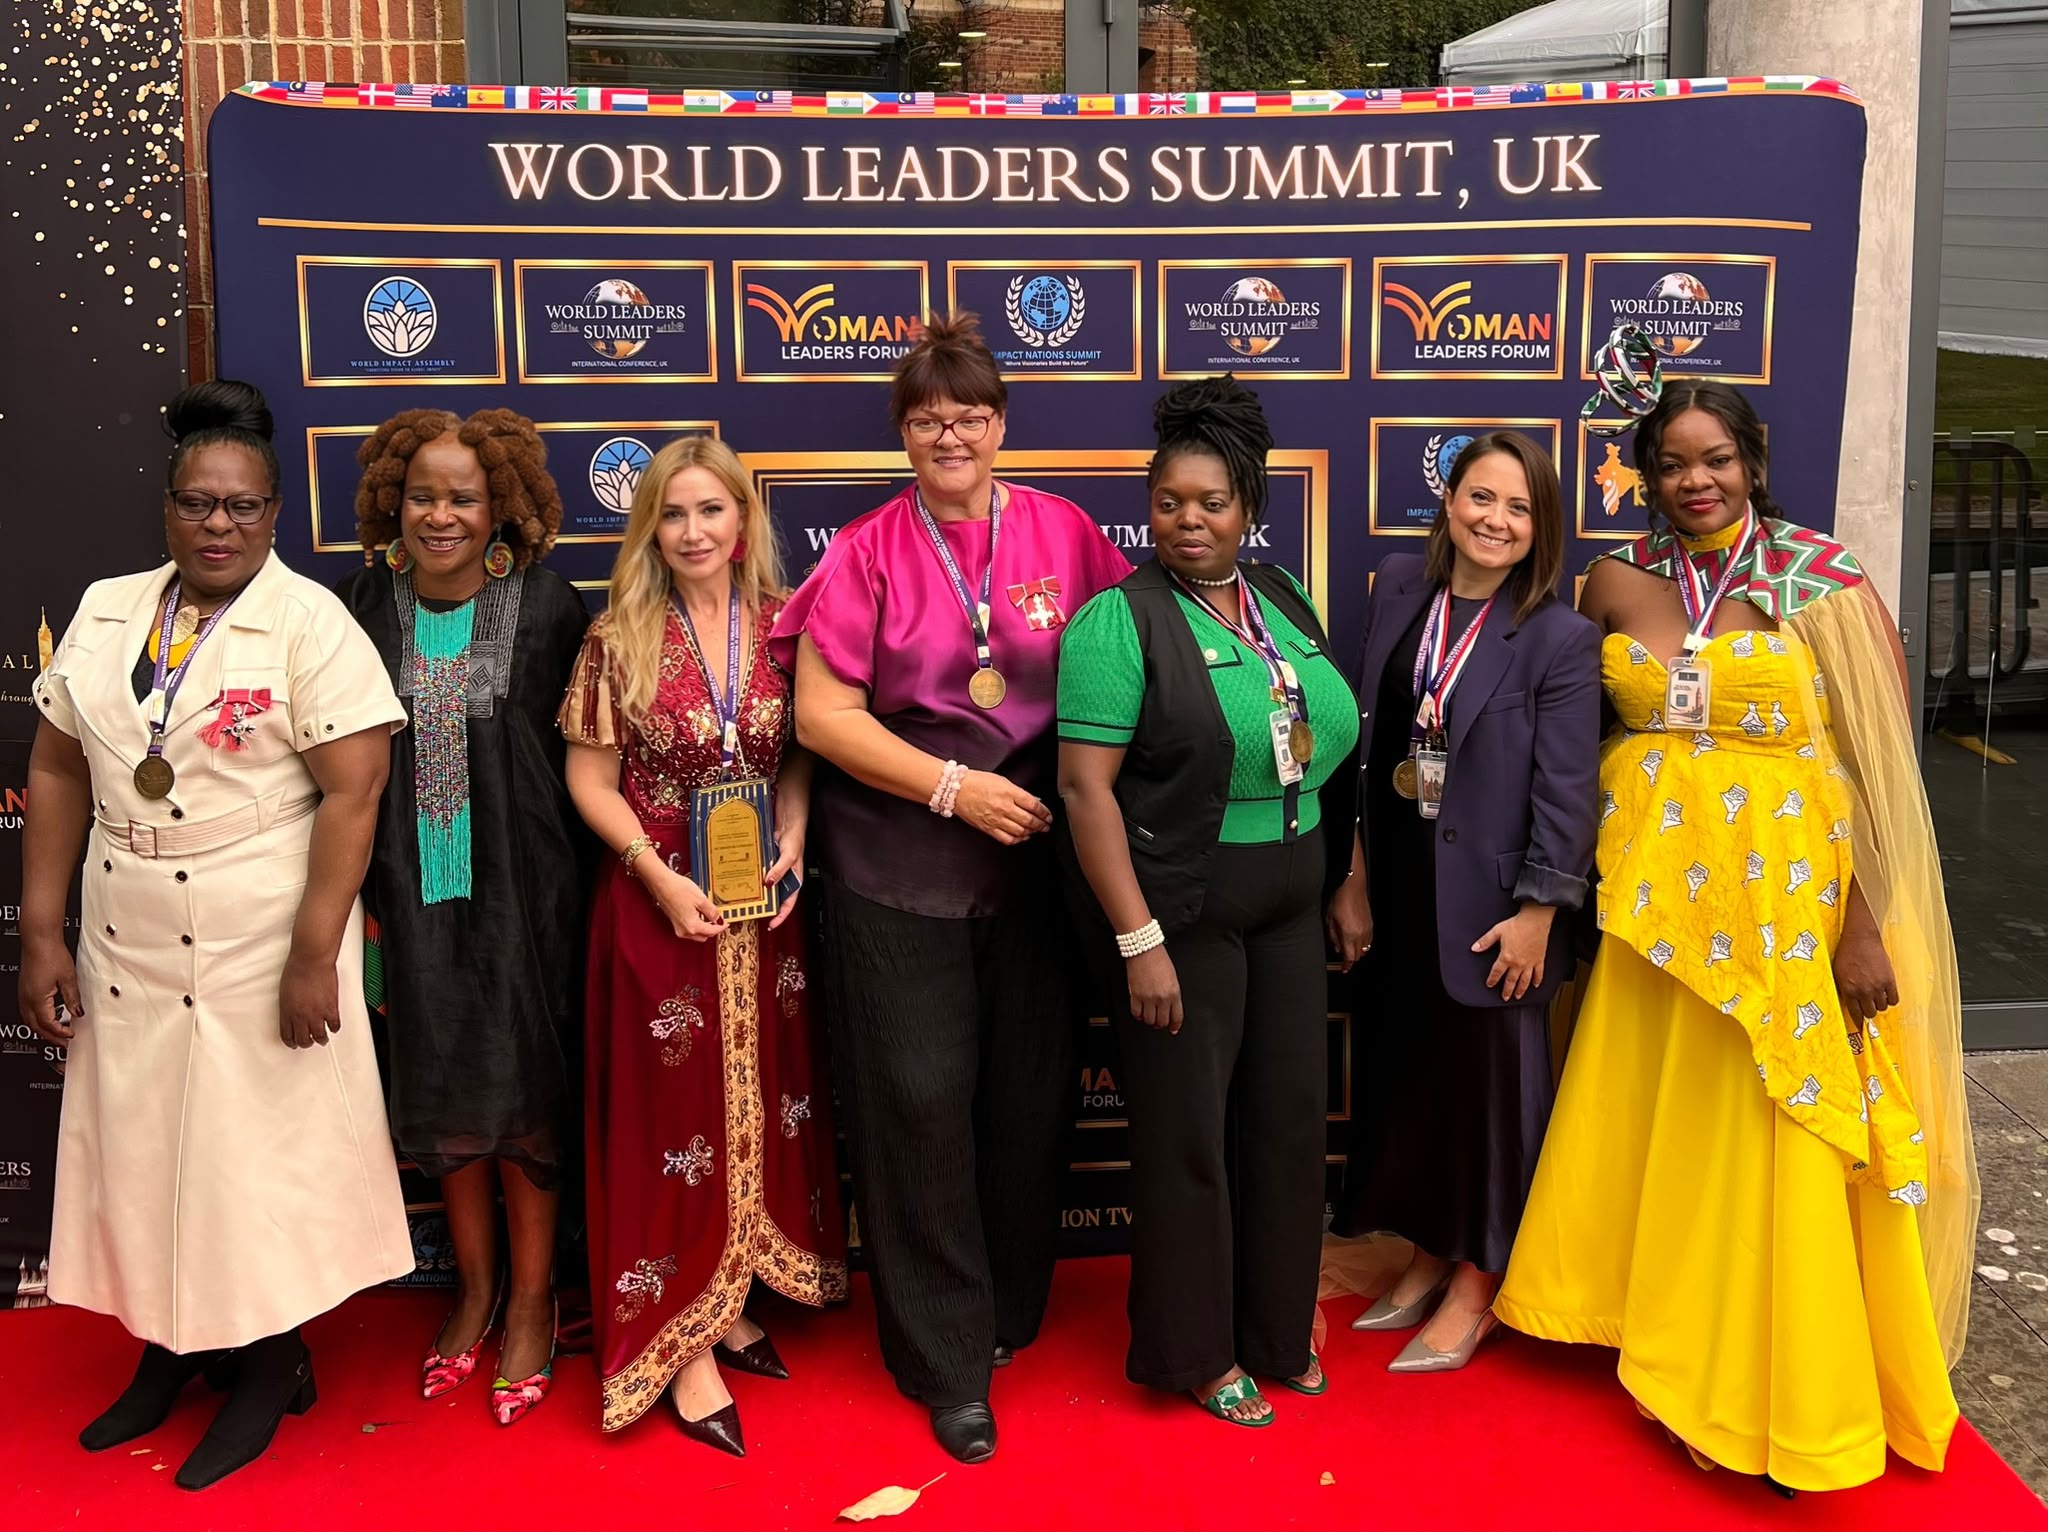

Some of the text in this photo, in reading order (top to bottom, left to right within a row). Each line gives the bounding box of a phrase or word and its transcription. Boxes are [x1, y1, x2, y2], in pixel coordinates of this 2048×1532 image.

[488, 143, 783, 201] WORLD
[801, 146, 1132, 203] LEADERS
[1493, 134, 1602, 194] UK
[545, 304, 686, 319] WORLD LEADERS
[1185, 302, 1320, 317] WORLD LEADERS
[1384, 281, 1551, 341] WOMAN
[1610, 299, 1743, 317] WORLD LEADERS
[583, 324, 653, 339] SUMMIT
[1220, 321, 1288, 336] SUMMIT
[1644, 320, 1711, 337] SUMMIT
[781, 345, 854, 360] LEADERS
[1025, 350, 1064, 360] NATIONS
[1065, 350, 1102, 360] SUMMIT
[1415, 344, 1550, 359] LEADERS FORUM
[414, 359, 456, 367] ASSEMBLY
